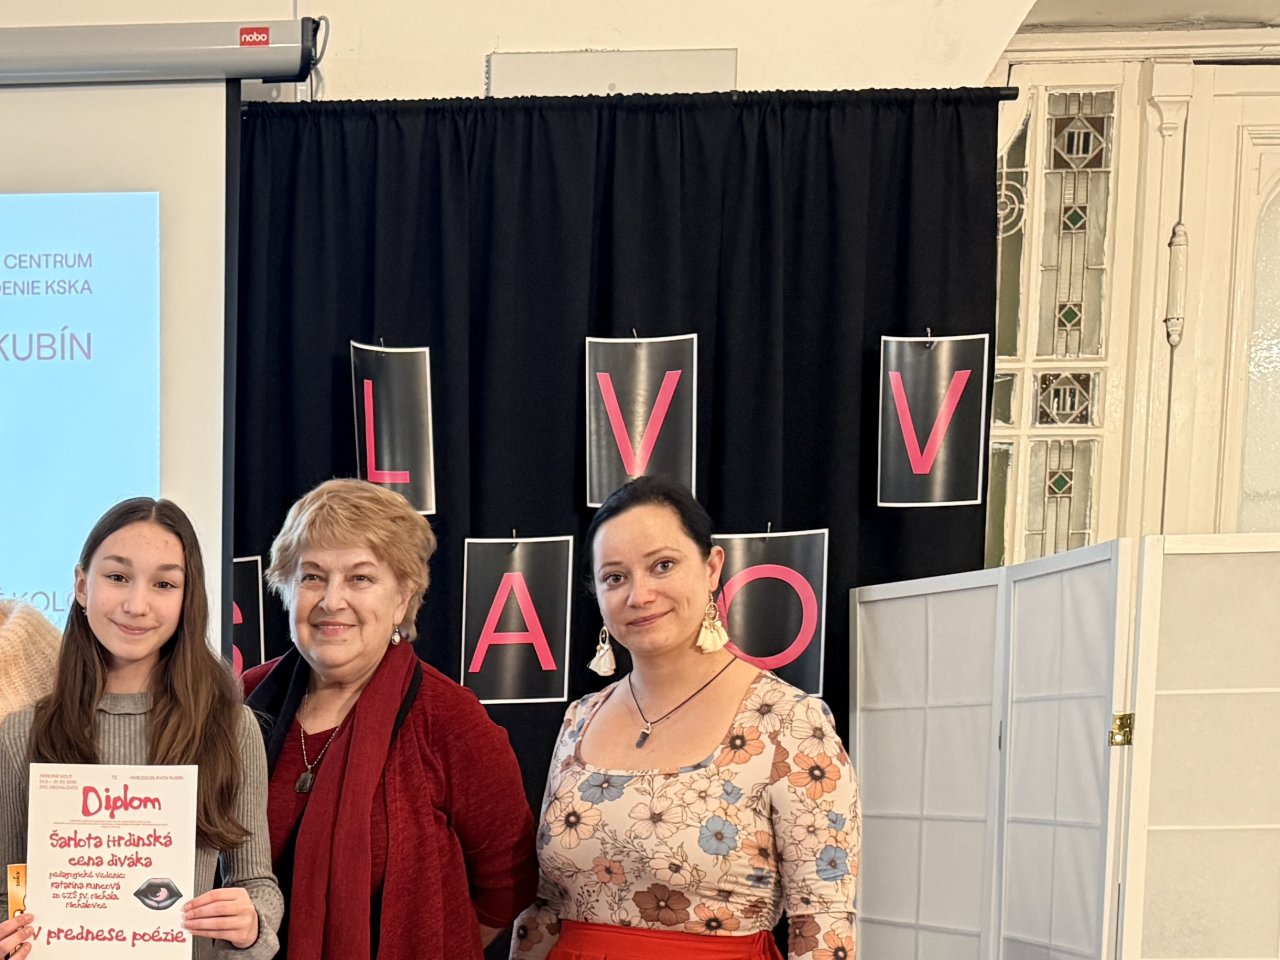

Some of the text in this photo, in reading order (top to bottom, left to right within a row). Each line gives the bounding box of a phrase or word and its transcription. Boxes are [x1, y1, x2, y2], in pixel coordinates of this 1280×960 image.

[241, 32, 267, 42] nobo
[4, 253, 93, 269] CENTRUM
[45, 279, 93, 295] KSKA
[363, 379, 410, 483] L
[468, 571, 557, 674] A
[596, 370, 682, 476] V
[888, 369, 972, 476] V
[81, 783, 161, 819] Diplom
[49, 828, 173, 849] Šarlota Hrdinská
[68, 851, 153, 867] cena diváka
[46, 925, 127, 945] prednese
[131, 926, 187, 947] poézie
